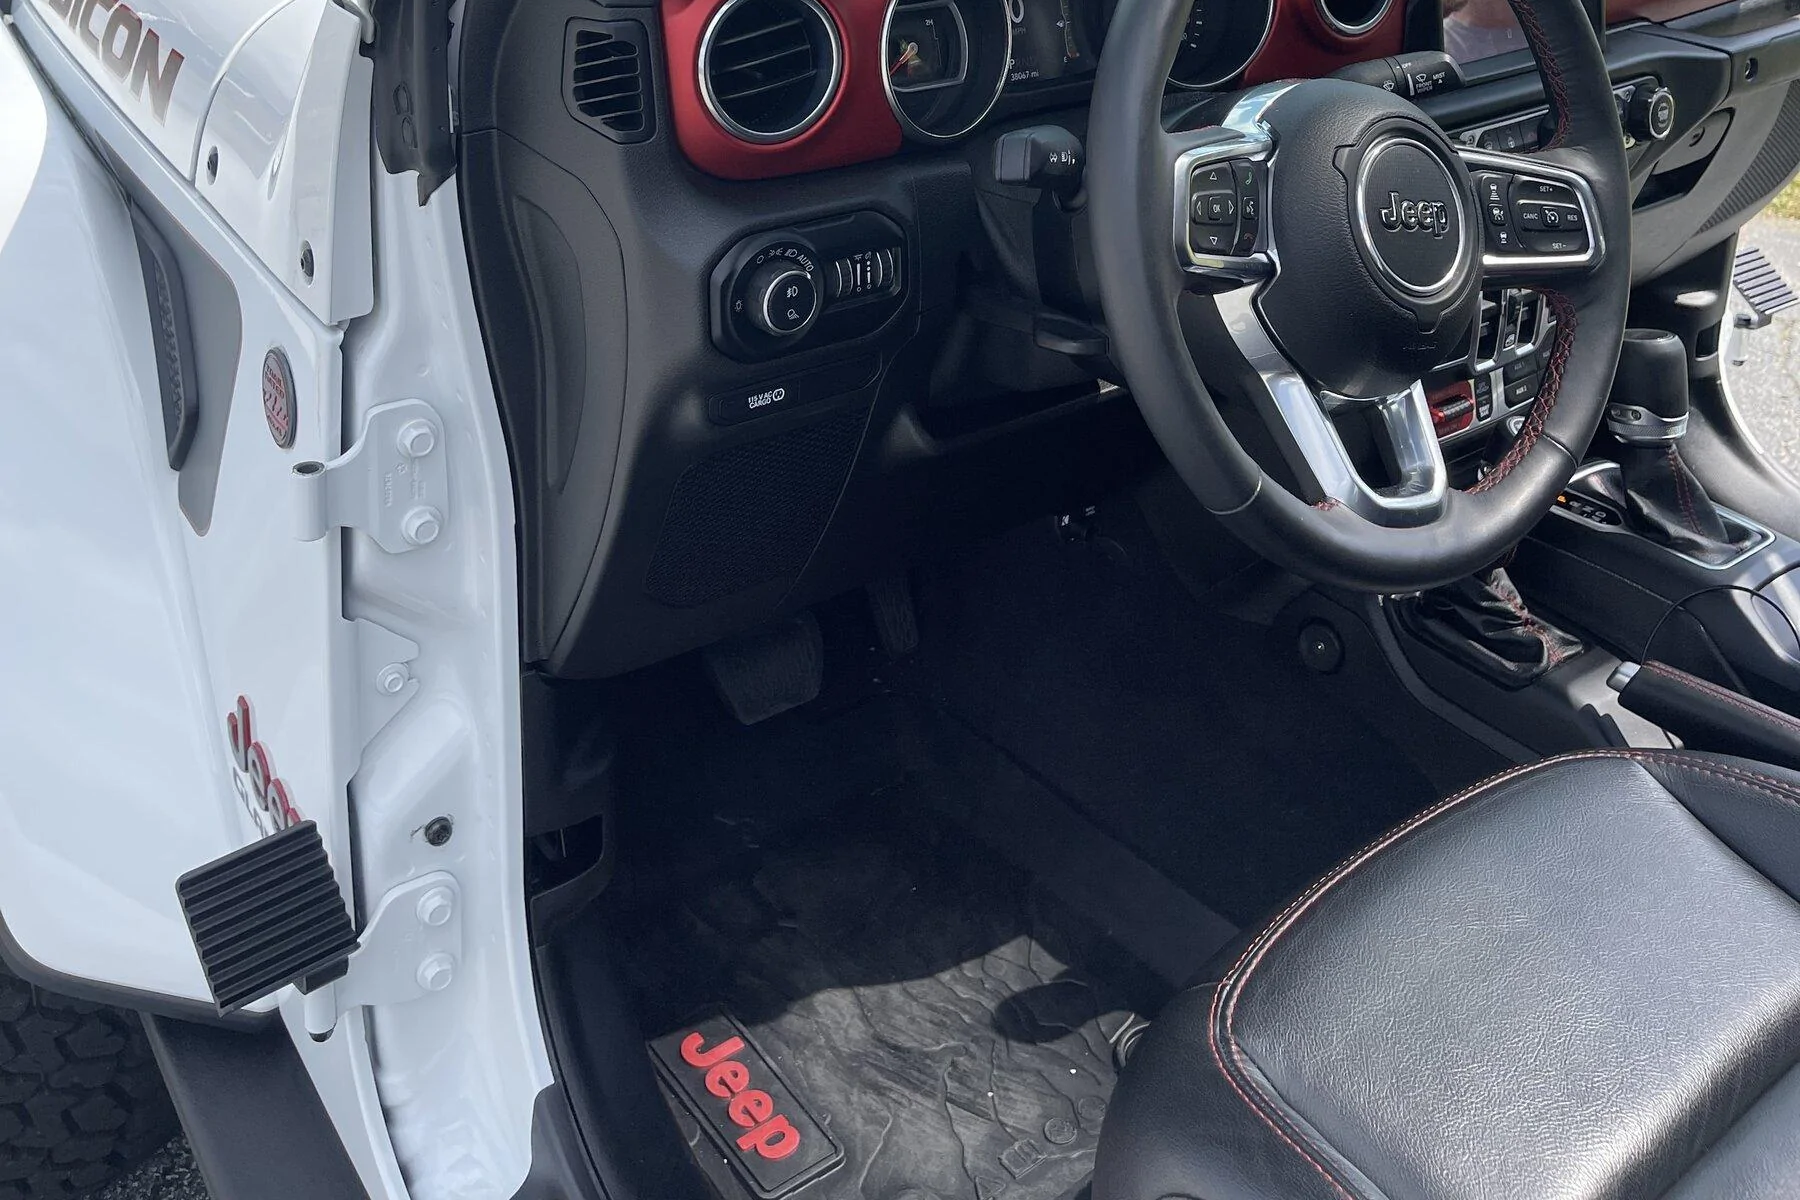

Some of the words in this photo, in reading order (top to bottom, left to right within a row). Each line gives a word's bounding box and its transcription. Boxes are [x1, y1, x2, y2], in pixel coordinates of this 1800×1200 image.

[1380, 191, 1449, 240] Jeep
[797, 254, 814, 272] AUTO
[749, 398, 771, 409] CARGO
[227, 695, 302, 832] Jee
[680, 1031, 801, 1161] Jeep
